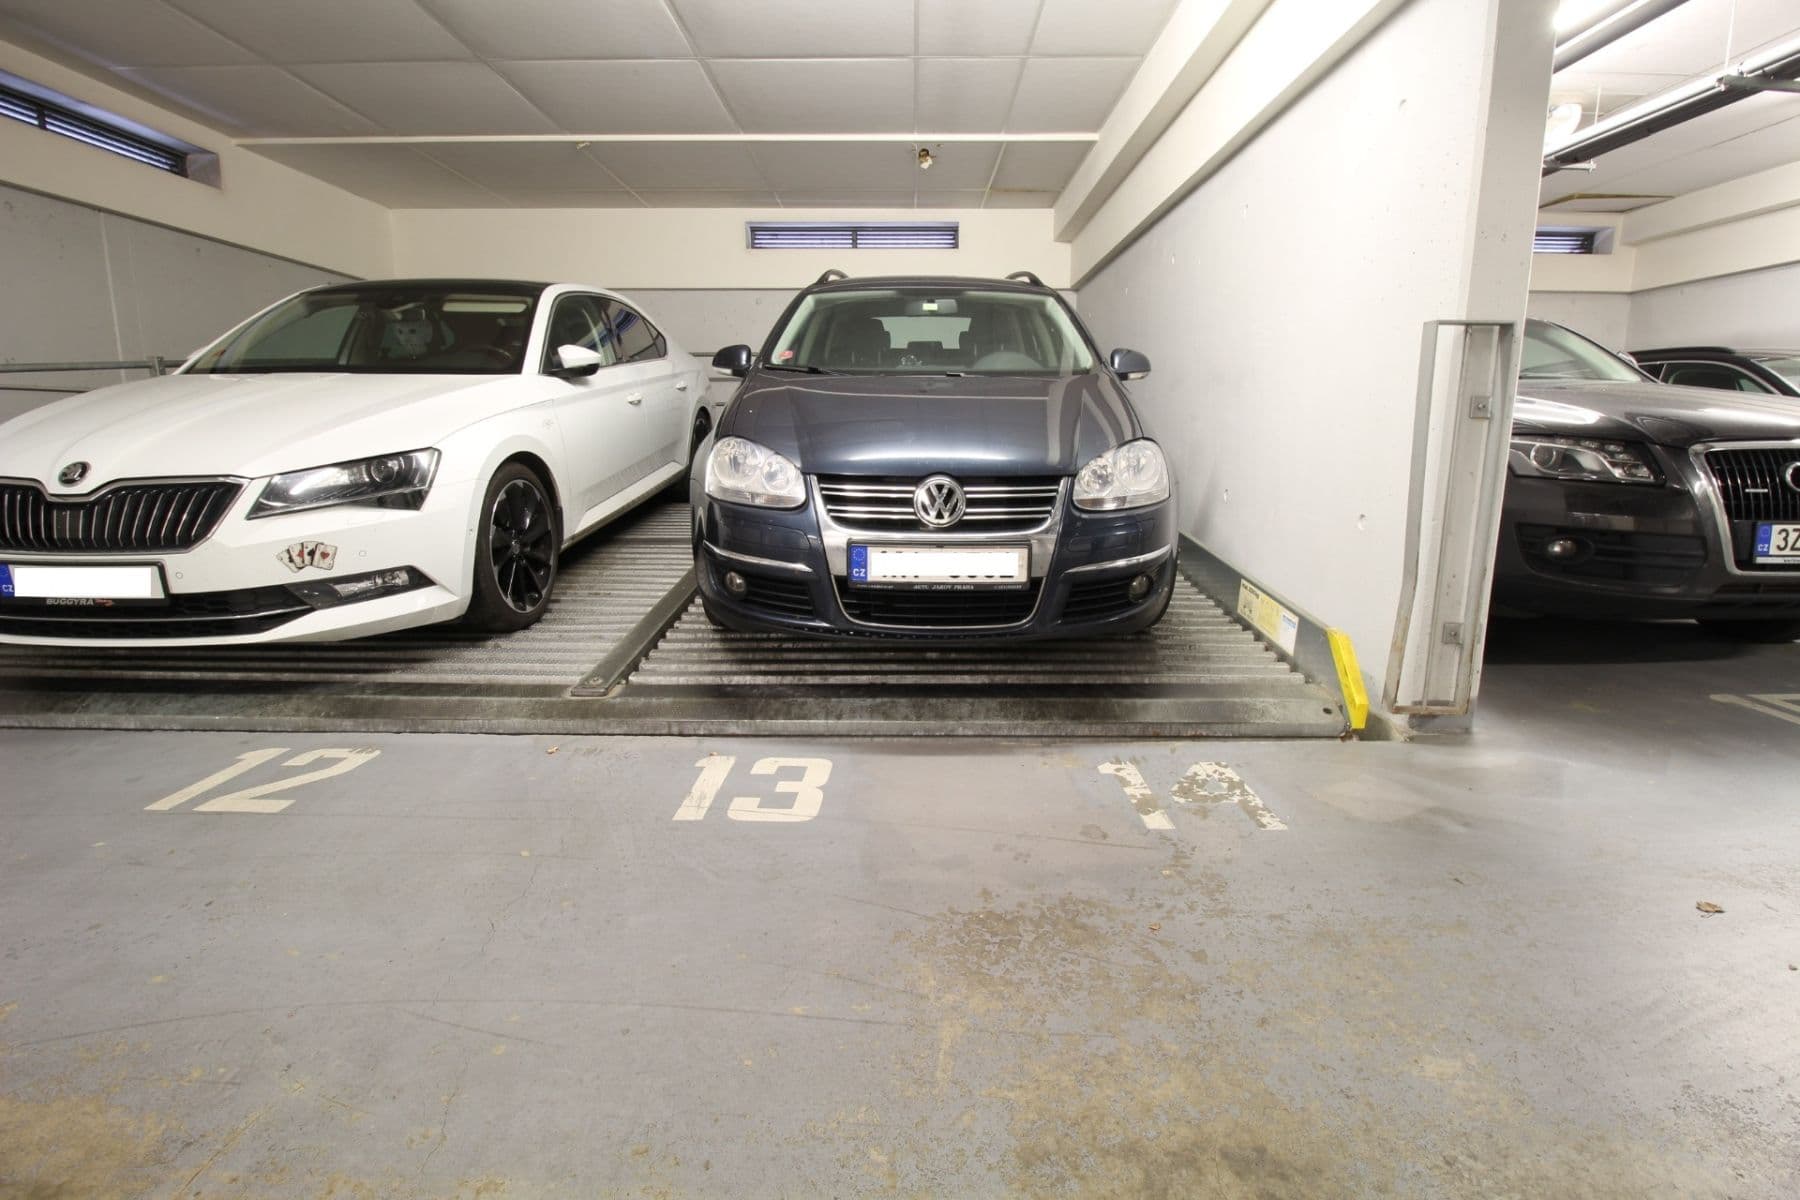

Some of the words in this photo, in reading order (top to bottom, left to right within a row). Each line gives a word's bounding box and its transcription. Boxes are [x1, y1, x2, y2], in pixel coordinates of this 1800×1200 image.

[1757, 543, 1769, 552] CZ
[852, 568, 866, 577] CZ
[2, 584, 14, 592] CZ
[46, 598, 94, 606] BUGGYRA
[143, 748, 381, 813] 12
[672, 756, 833, 822] 13
